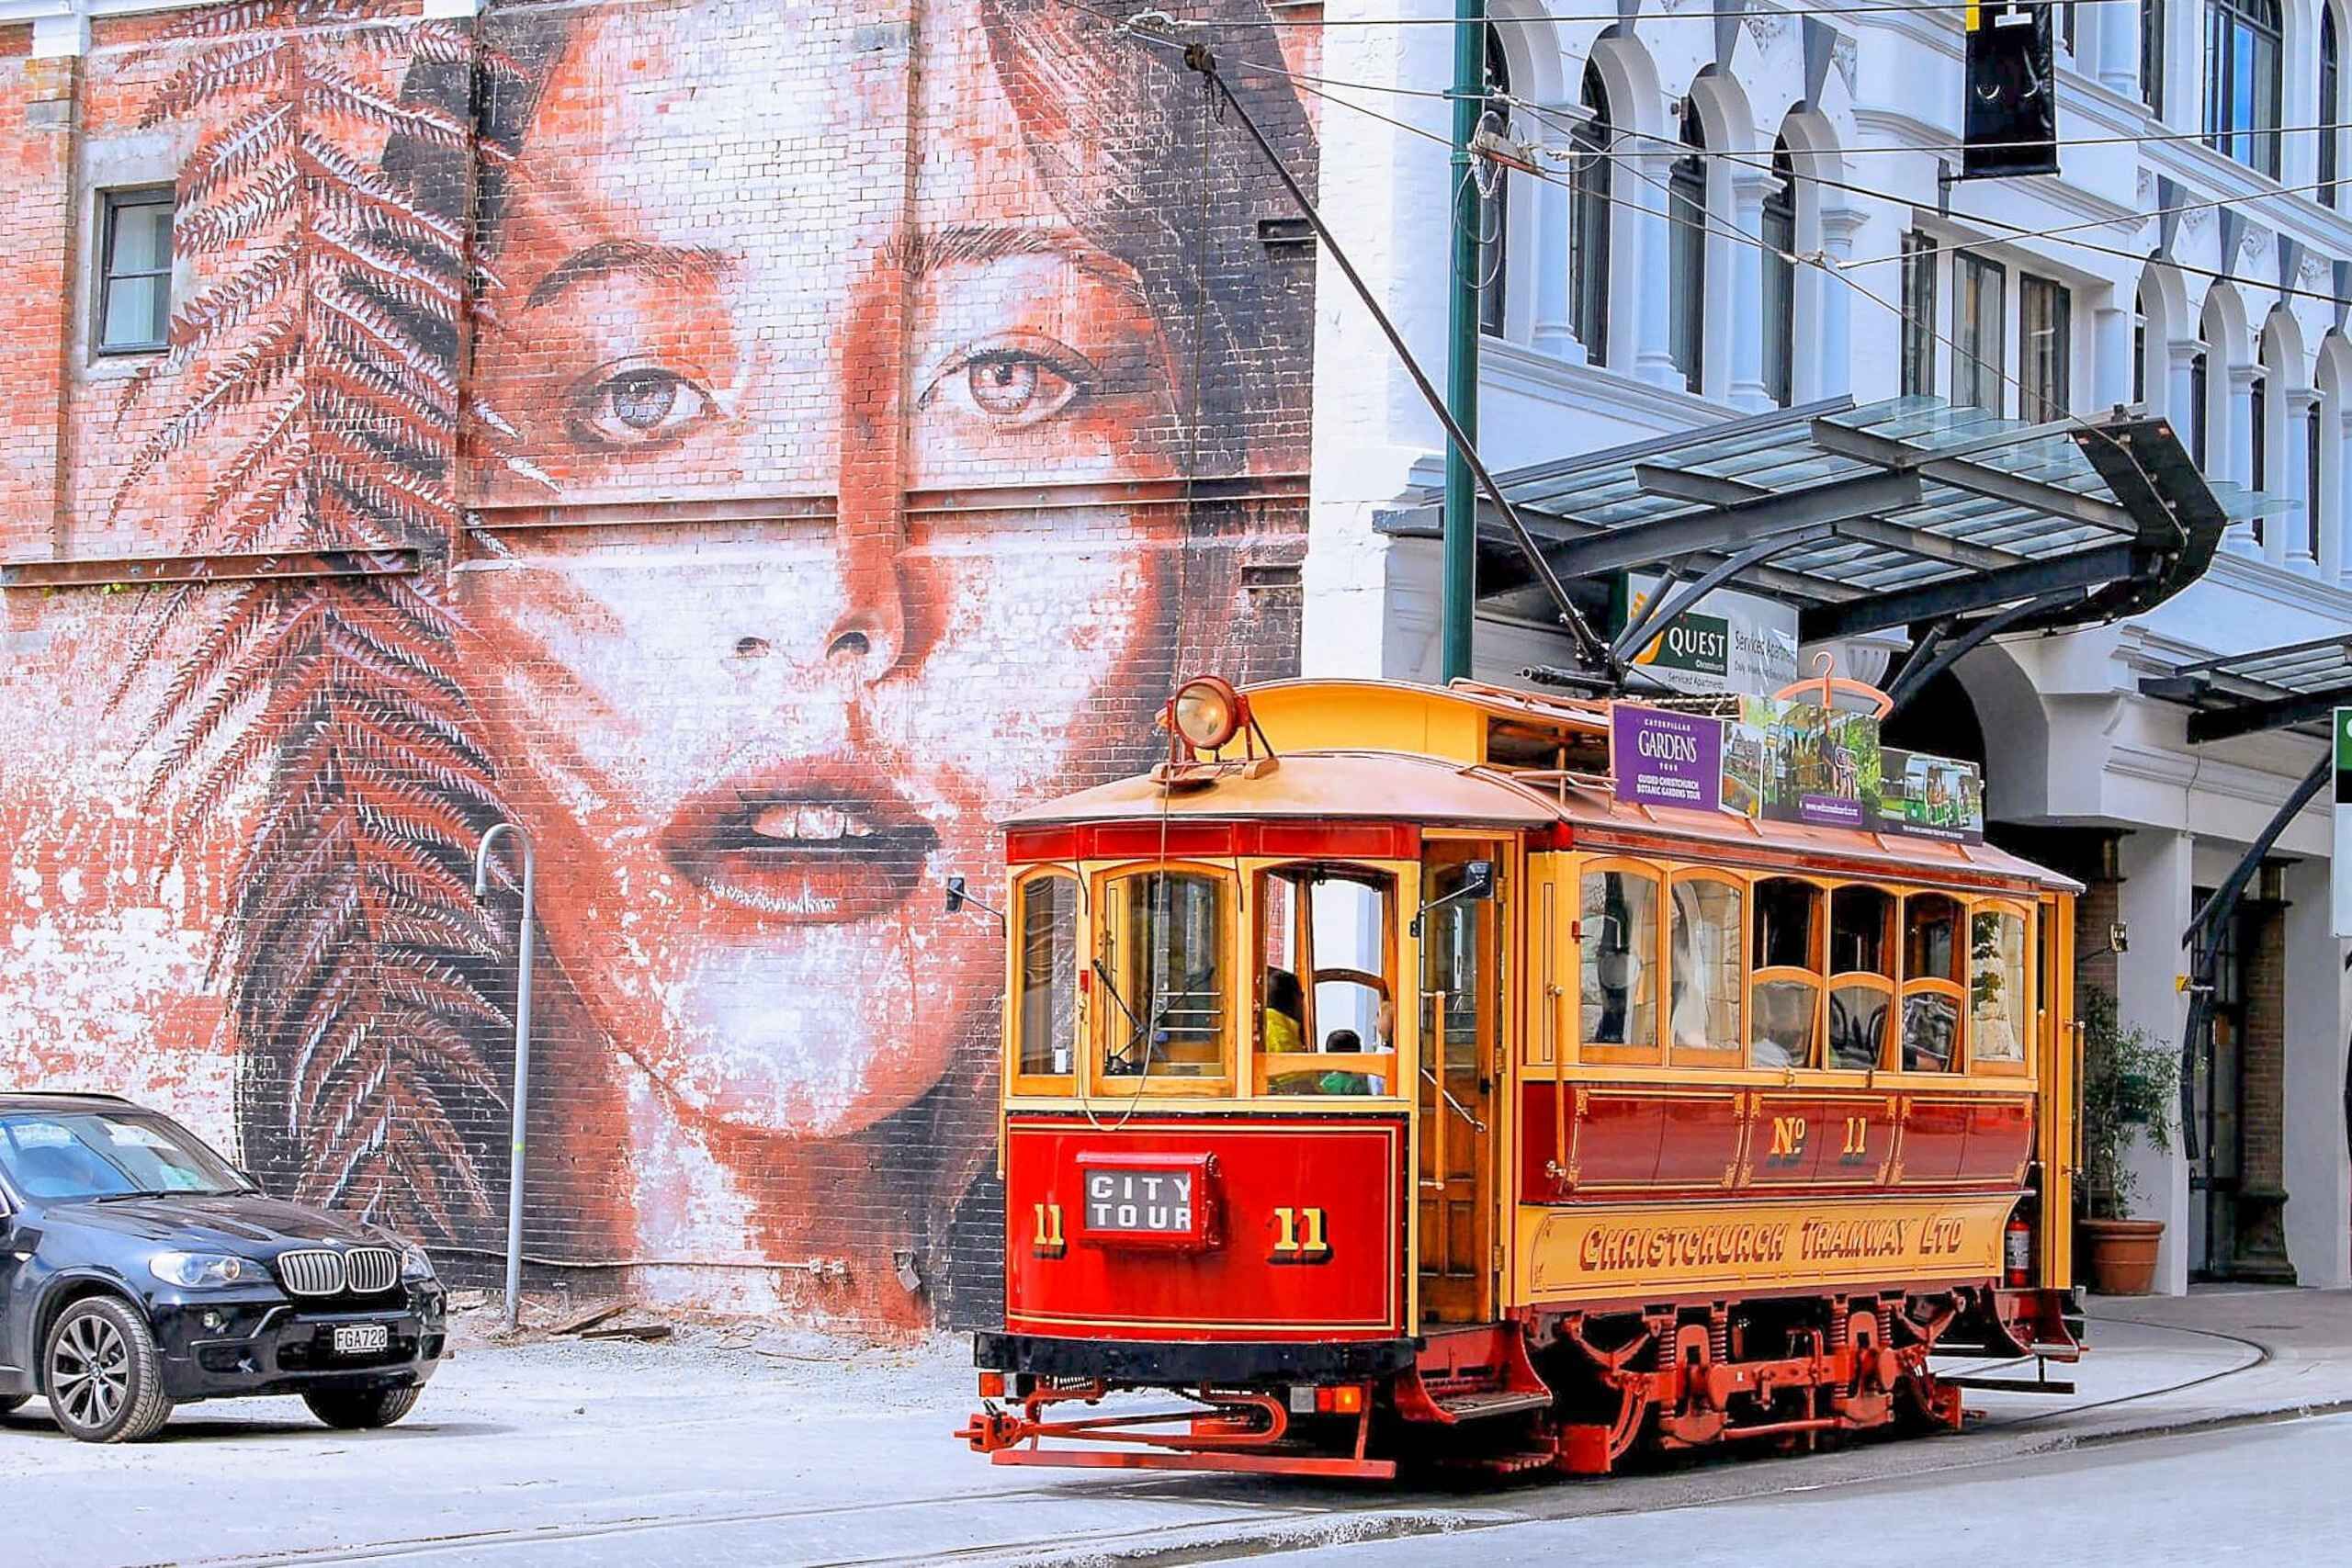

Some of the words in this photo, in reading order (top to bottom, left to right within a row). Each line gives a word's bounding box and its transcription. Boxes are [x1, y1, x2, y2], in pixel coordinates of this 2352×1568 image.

[1668, 626, 1725, 658] QUEST
[1645, 717, 1691, 732] CATERPILLAR
[1638, 729, 1697, 763] GARDENS
[1843, 1117, 1867, 1154] 11
[1091, 1176, 1192, 1201] CITY
[1034, 1203, 1066, 1246] 11
[1091, 1202, 1192, 1230] TOUR
[1273, 1207, 1328, 1251] 11
[1579, 1224, 1790, 1271] CHRISTCHURCH
[1802, 1216, 1917, 1260] TRAMWAY
[1919, 1213, 1965, 1255] LTD
